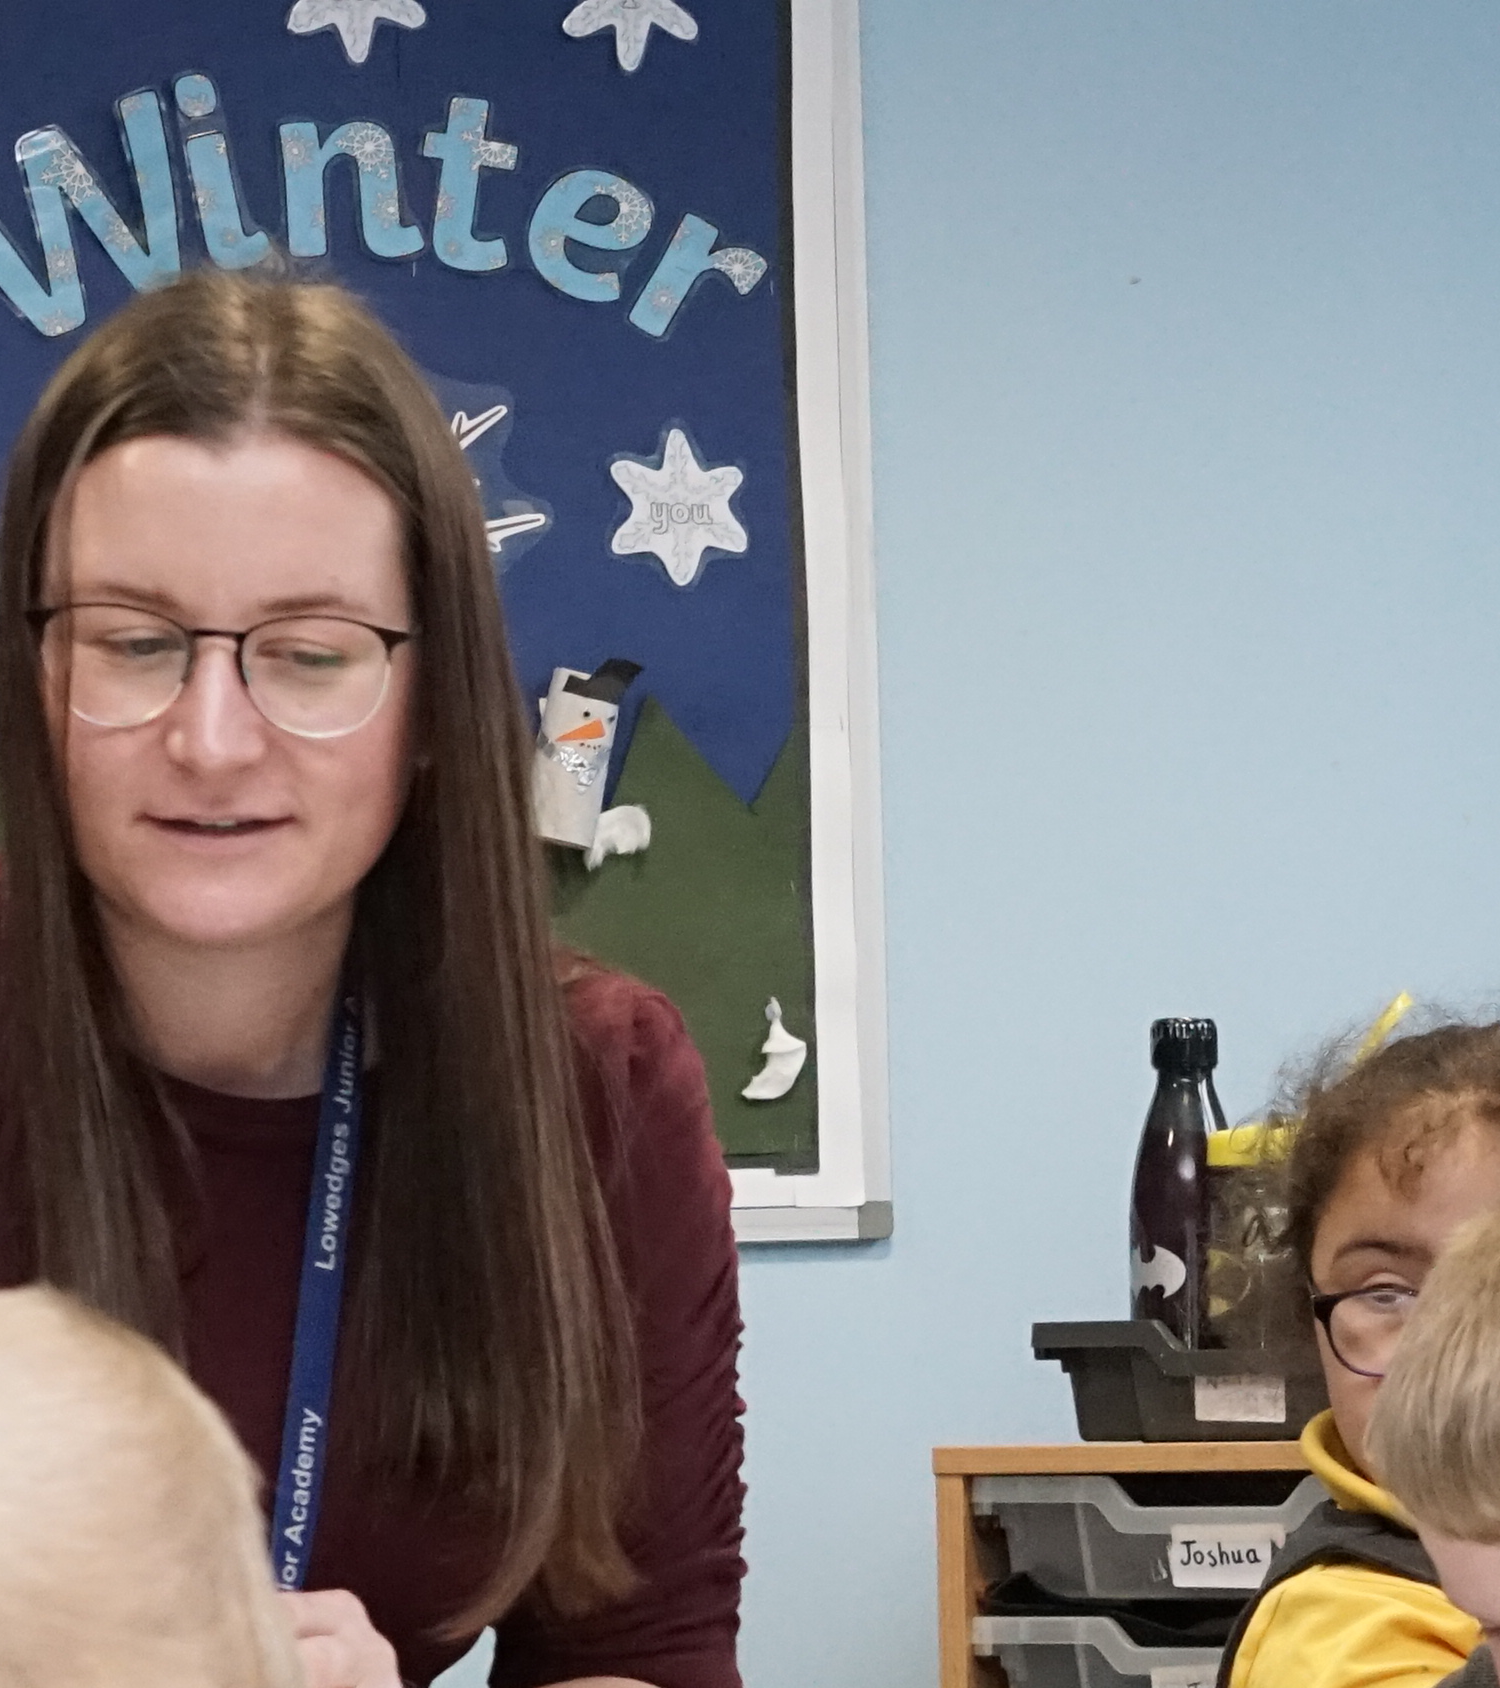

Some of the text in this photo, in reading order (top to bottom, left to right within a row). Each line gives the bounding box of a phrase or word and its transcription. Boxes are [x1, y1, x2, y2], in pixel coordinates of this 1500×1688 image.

[649, 497, 715, 536] you
[315, 1122, 351, 1271] Lowedges
[283, 1406, 324, 1547] Academy
[1178, 1540, 1262, 1568] Joshua
